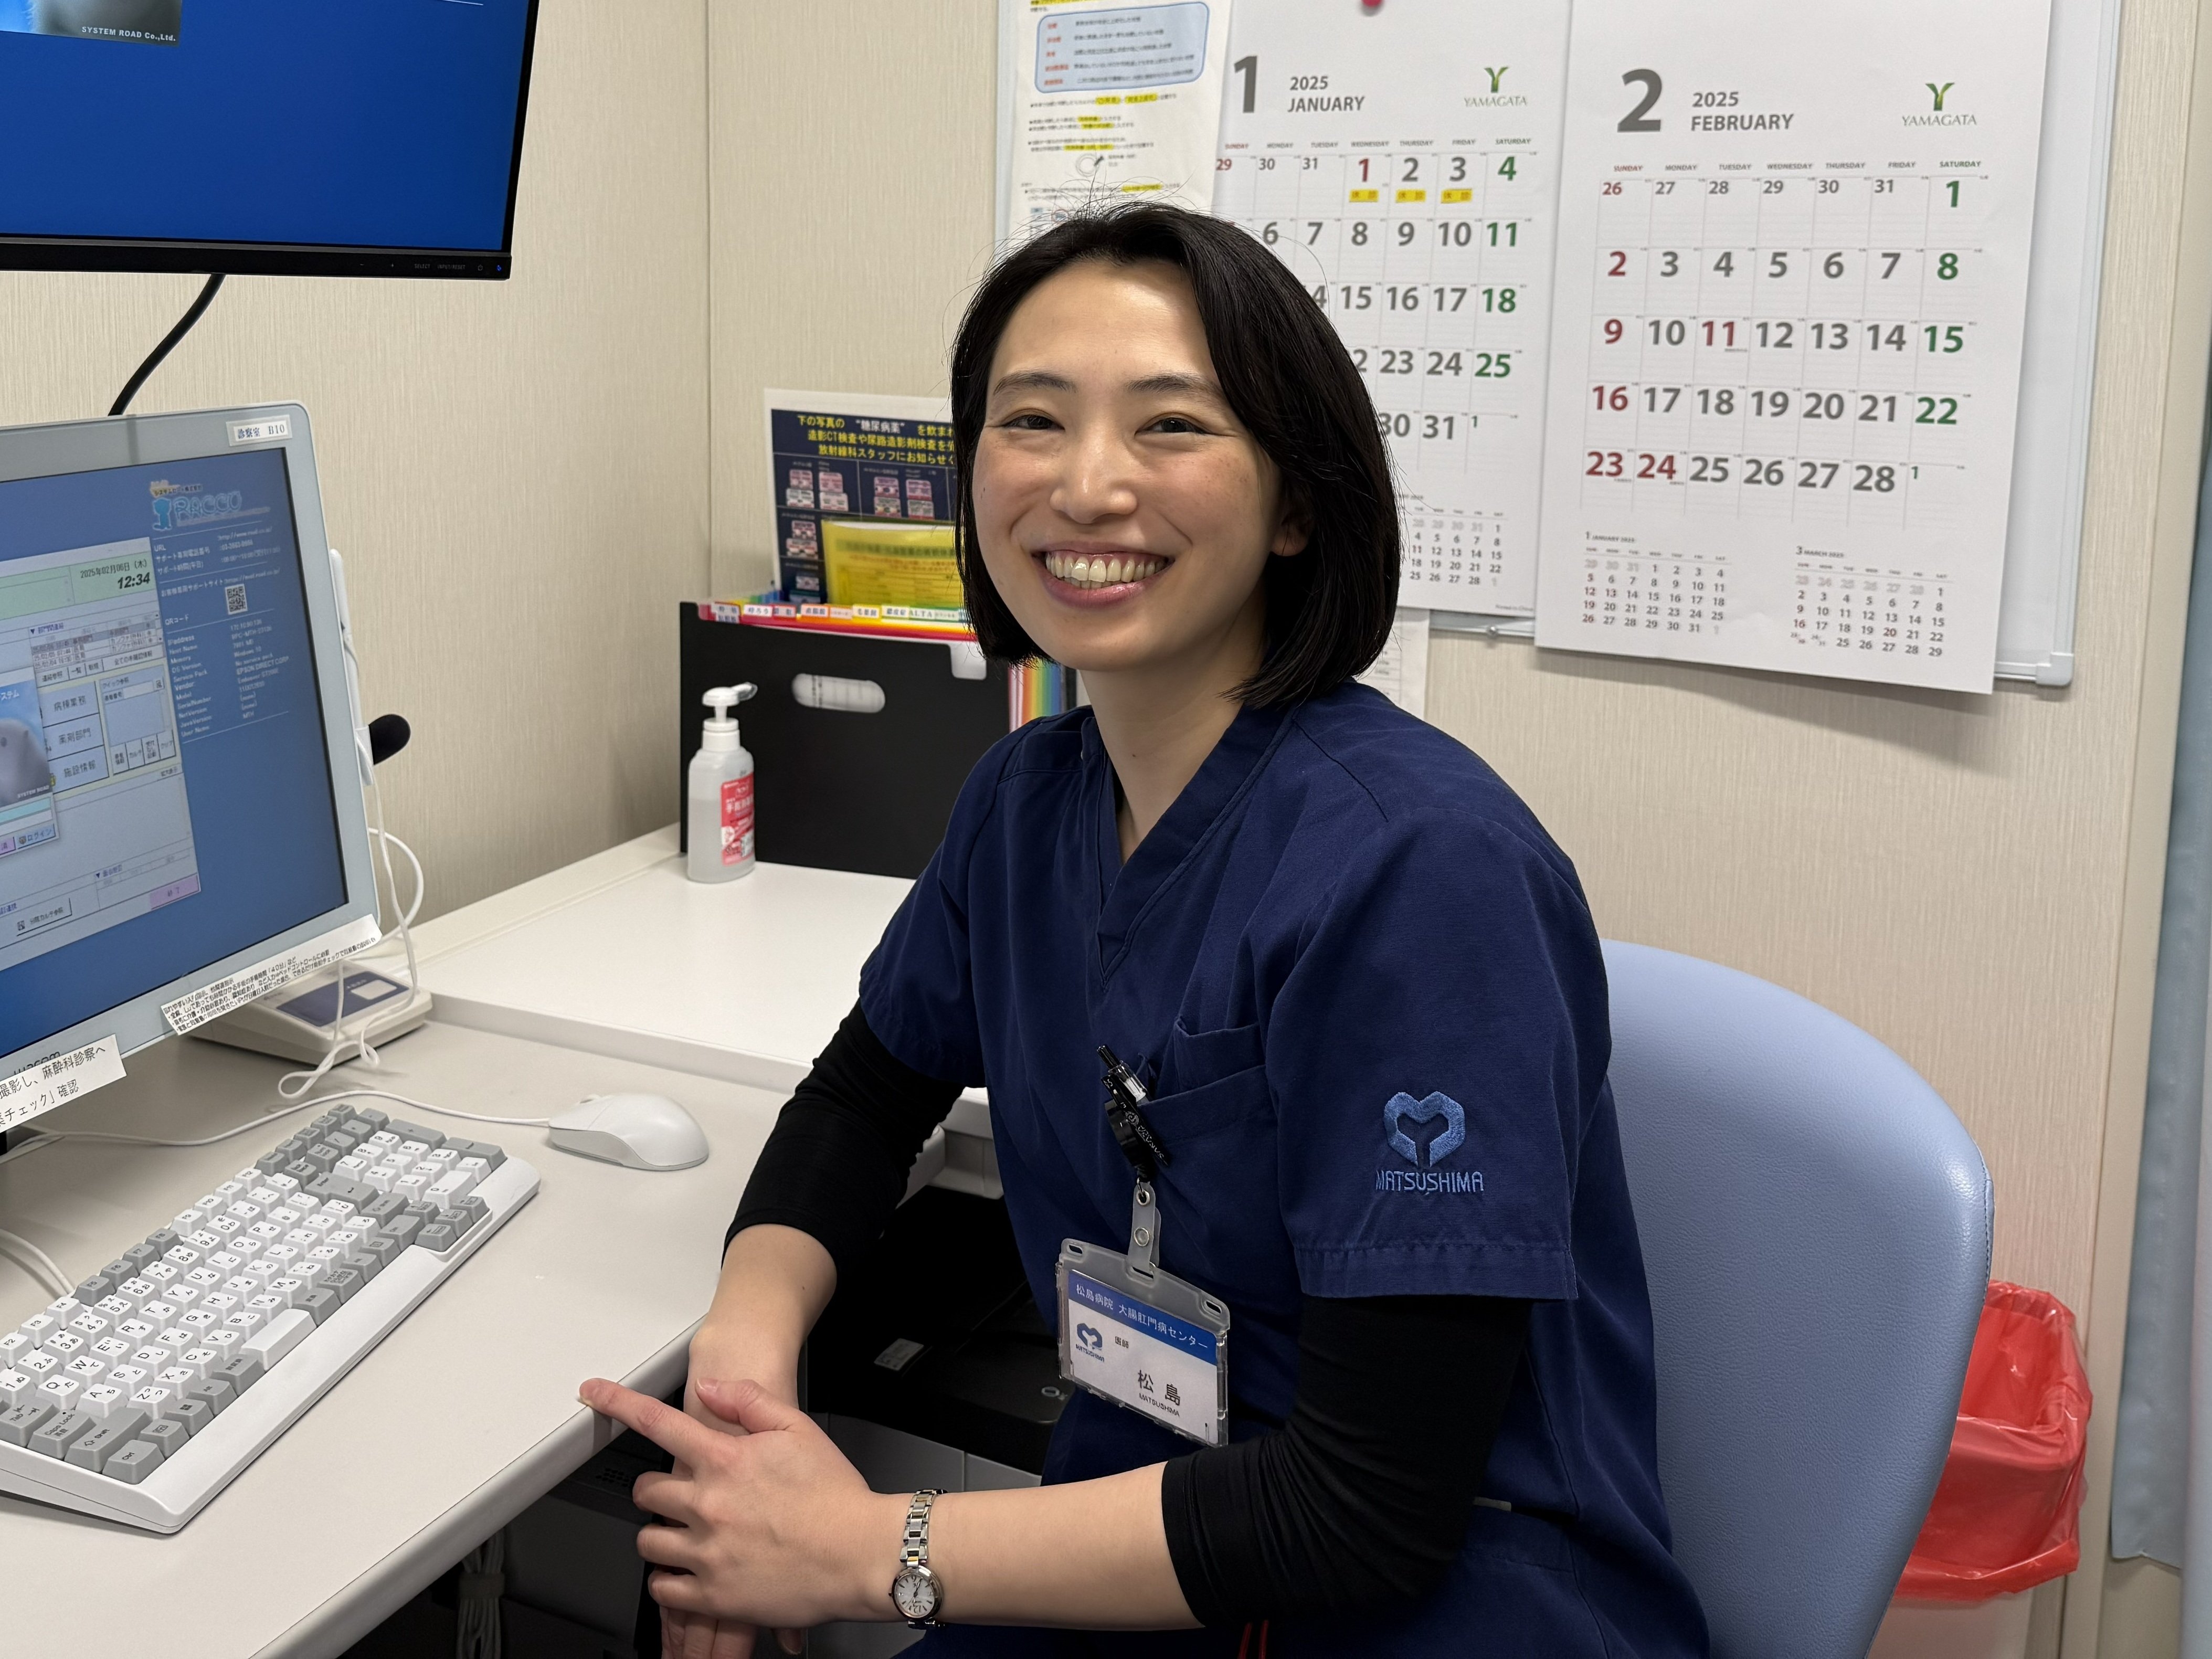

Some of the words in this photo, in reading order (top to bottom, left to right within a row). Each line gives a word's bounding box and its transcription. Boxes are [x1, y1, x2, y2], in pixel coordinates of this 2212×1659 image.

[82, 26, 116, 36] SYSTEM
[119, 29, 142, 38] ROAD
[145, 33, 176, 41] Co.,Ltd.
[1234, 56, 1257, 113] 1
[1290, 76, 1328, 90] 2025
[1288, 97, 1364, 112] JANUARY
[1465, 96, 1526, 107] YAMAGATA
[1617, 69, 1662, 132] 2
[1692, 92, 1739, 107] 2025
[1691, 114, 1794, 131] FEBRUARY
[1902, 115, 1976, 125] YAMAGATA
[1216, 158, 1232, 171] 29
[1259, 158, 1275, 170] 30
[1303, 157, 1317, 170] 31
[1359, 158, 1369, 182] 1
[1402, 157, 1418, 182] 2
[1450, 157, 1466, 181] 3
[1498, 156, 1517, 181] 4
[1603, 182, 1622, 195] 26
[1655, 182, 1675, 194] 27
[1709, 181, 1729, 194] 28
[1763, 181, 1783, 194] 29
[1819, 180, 1839, 193] 30
[1875, 179, 1893, 193] 31
[1946, 181, 1959, 207] 1
[1263, 222, 1278, 245] 6
[1308, 222, 1323, 245] 7
[1352, 222, 1367, 246] 8
[1398, 222, 1414, 246] 9
[1438, 222, 1472, 246] 10
[1487, 223, 1517, 247] 11
[1608, 251, 1626, 276] 2
[1661, 251, 1678, 277] 3
[1713, 252, 1734, 277] 4
[1769, 252, 1787, 278] 5
[1824, 252, 1844, 278] 6
[1882, 253, 1900, 279] 7
[1938, 253, 1958, 280] 8
[1311, 286, 1327, 309] 4
[1341, 286, 1371, 310] 15
[1387, 287, 1419, 311] 16
[1434, 288, 1467, 311] 17
[1483, 289, 1516, 313] 18
[1605, 319, 1622, 344] 9
[1649, 320, 1685, 345] 10
[1702, 321, 1734, 346] 11
[1756, 322, 1793, 348] 12
[1812, 323, 1848, 350] 13
[1867, 324, 1906, 351] 14
[1925, 326, 1963, 353] 15
[1353, 349, 1368, 373] 2
[1380, 350, 1413, 374] 23
[1427, 352, 1462, 376] 24
[1475, 353, 1510, 378] 25
[1593, 386, 1628, 411] 16
[1645, 387, 1680, 413] 17
[1698, 389, 1733, 415] 18
[1752, 391, 1788, 417] 19
[1803, 393, 1844, 419] 20
[1859, 395, 1896, 422] 21
[1915, 397, 1957, 425] 22
[268, 424, 284, 435] B10
[798, 415, 845, 428] 下の写真の
[1379, 413, 1410, 437] 30
[1423, 415, 1454, 439] 31
[1472, 416, 1477, 427] 1
[1586, 451, 1623, 477] 23
[1637, 454, 1676, 480] 24
[1690, 457, 1729, 482] 25
[1744, 459, 1784, 485] 26
[1798, 462, 1839, 488] 27
[1854, 465, 1895, 492] 28
[1912, 466, 1918, 479] 1
[1585, 531, 1590, 540] 1
[1432, 546, 1442, 555] 12
[1796, 546, 1803, 555] 3
[80, 563, 130, 578] 2025年02月06日
[118, 572, 150, 589] 12:34
[1585, 586, 1595, 596] 12
[165, 614, 189, 626] QRコード
[1794, 619, 1806, 628] 16
[175, 682, 195, 690] Vendor
[176, 692, 192, 700] Model
[64, 760, 96, 777] 施設情報
[27, 828, 52, 841] ログイン
[1376, 1170, 1484, 1193] MATSUSHIMA
[1076, 1284, 1113, 1310] 松島病院
[1119, 1304, 1208, 1348] 大腸肛門病センター
[71, 1360, 86, 1369] W
[1139, 1393, 1180, 1417] MATSUSHIMA
[10, 1413, 24, 1422] Tab
[59, 1413, 75, 1425] Lock
